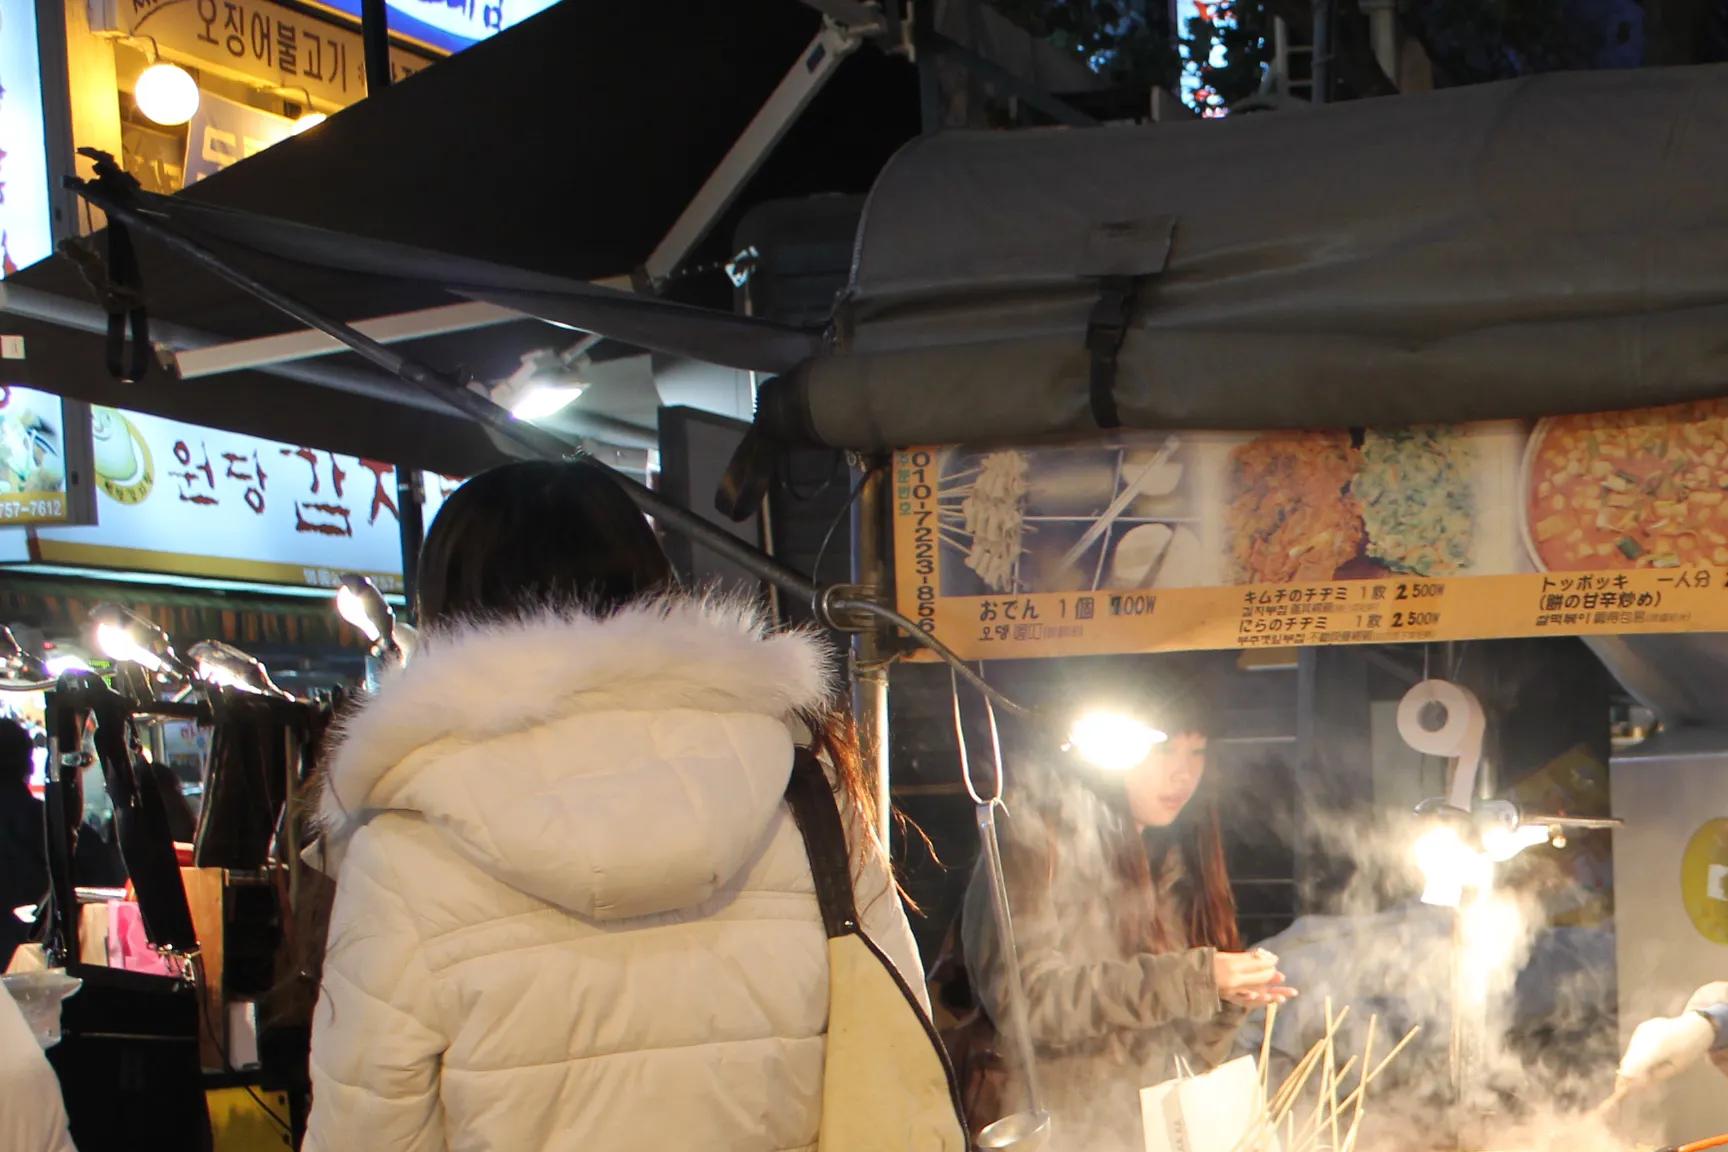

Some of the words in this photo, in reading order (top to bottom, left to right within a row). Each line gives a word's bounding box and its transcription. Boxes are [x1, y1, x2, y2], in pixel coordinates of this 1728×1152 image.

[1658, 570, 1711, 589] 一人分
[979, 598, 1040, 622] おでん
